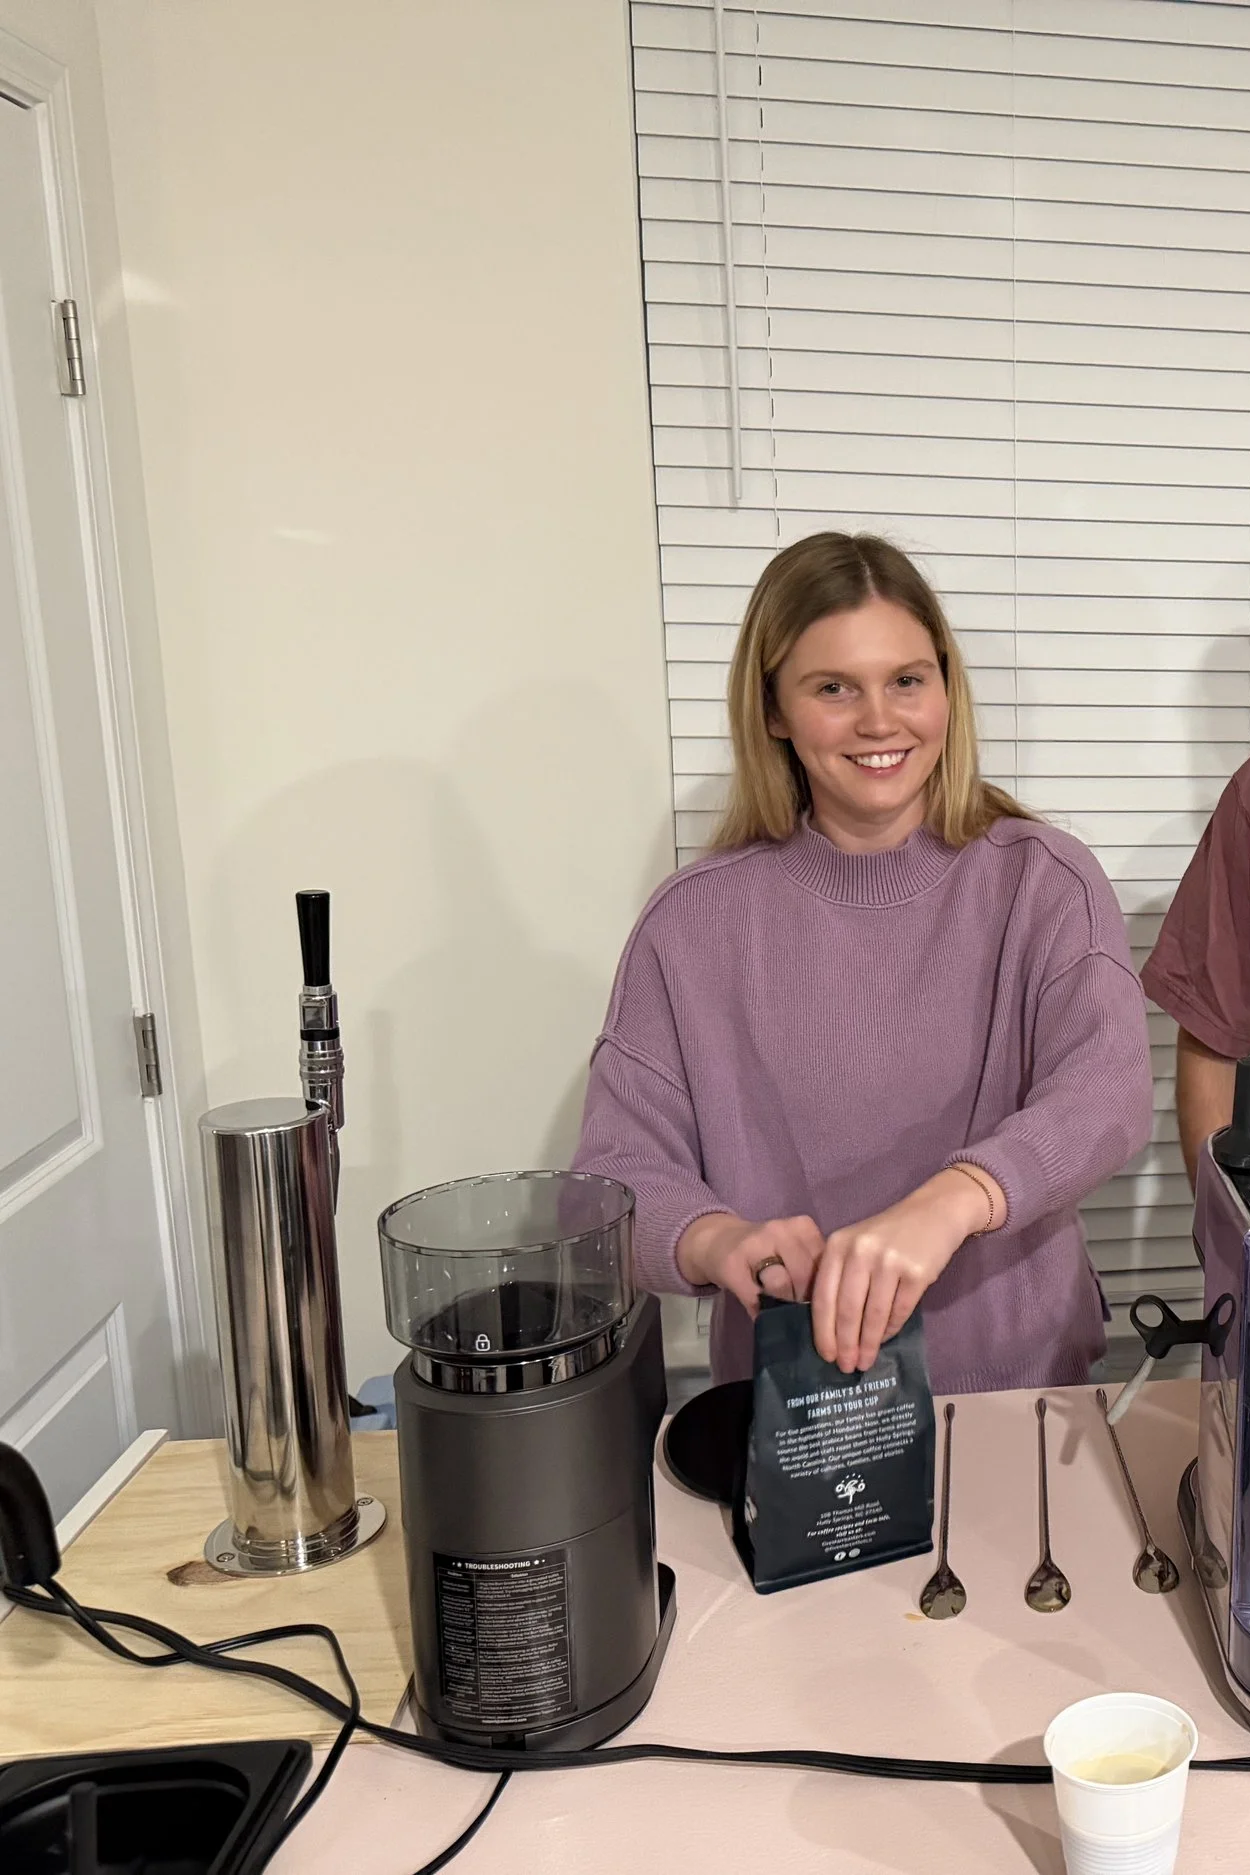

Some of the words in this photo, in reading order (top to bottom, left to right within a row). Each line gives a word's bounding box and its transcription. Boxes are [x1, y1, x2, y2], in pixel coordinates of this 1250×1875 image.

[787, 1396, 805, 1409] FROM
[806, 1393, 819, 1405] OUR
[821, 1387, 854, 1401] FAMILY'S
[856, 1385, 863, 1395] &
[864, 1377, 897, 1392] FRIEND'S
[808, 1406, 832, 1420] FARMS
[833, 1404, 843, 1414] TO
[844, 1400, 863, 1412] YOUR
[865, 1395, 879, 1407] CUP
[465, 1561, 531, 1570] TROUBLESHOOTING
